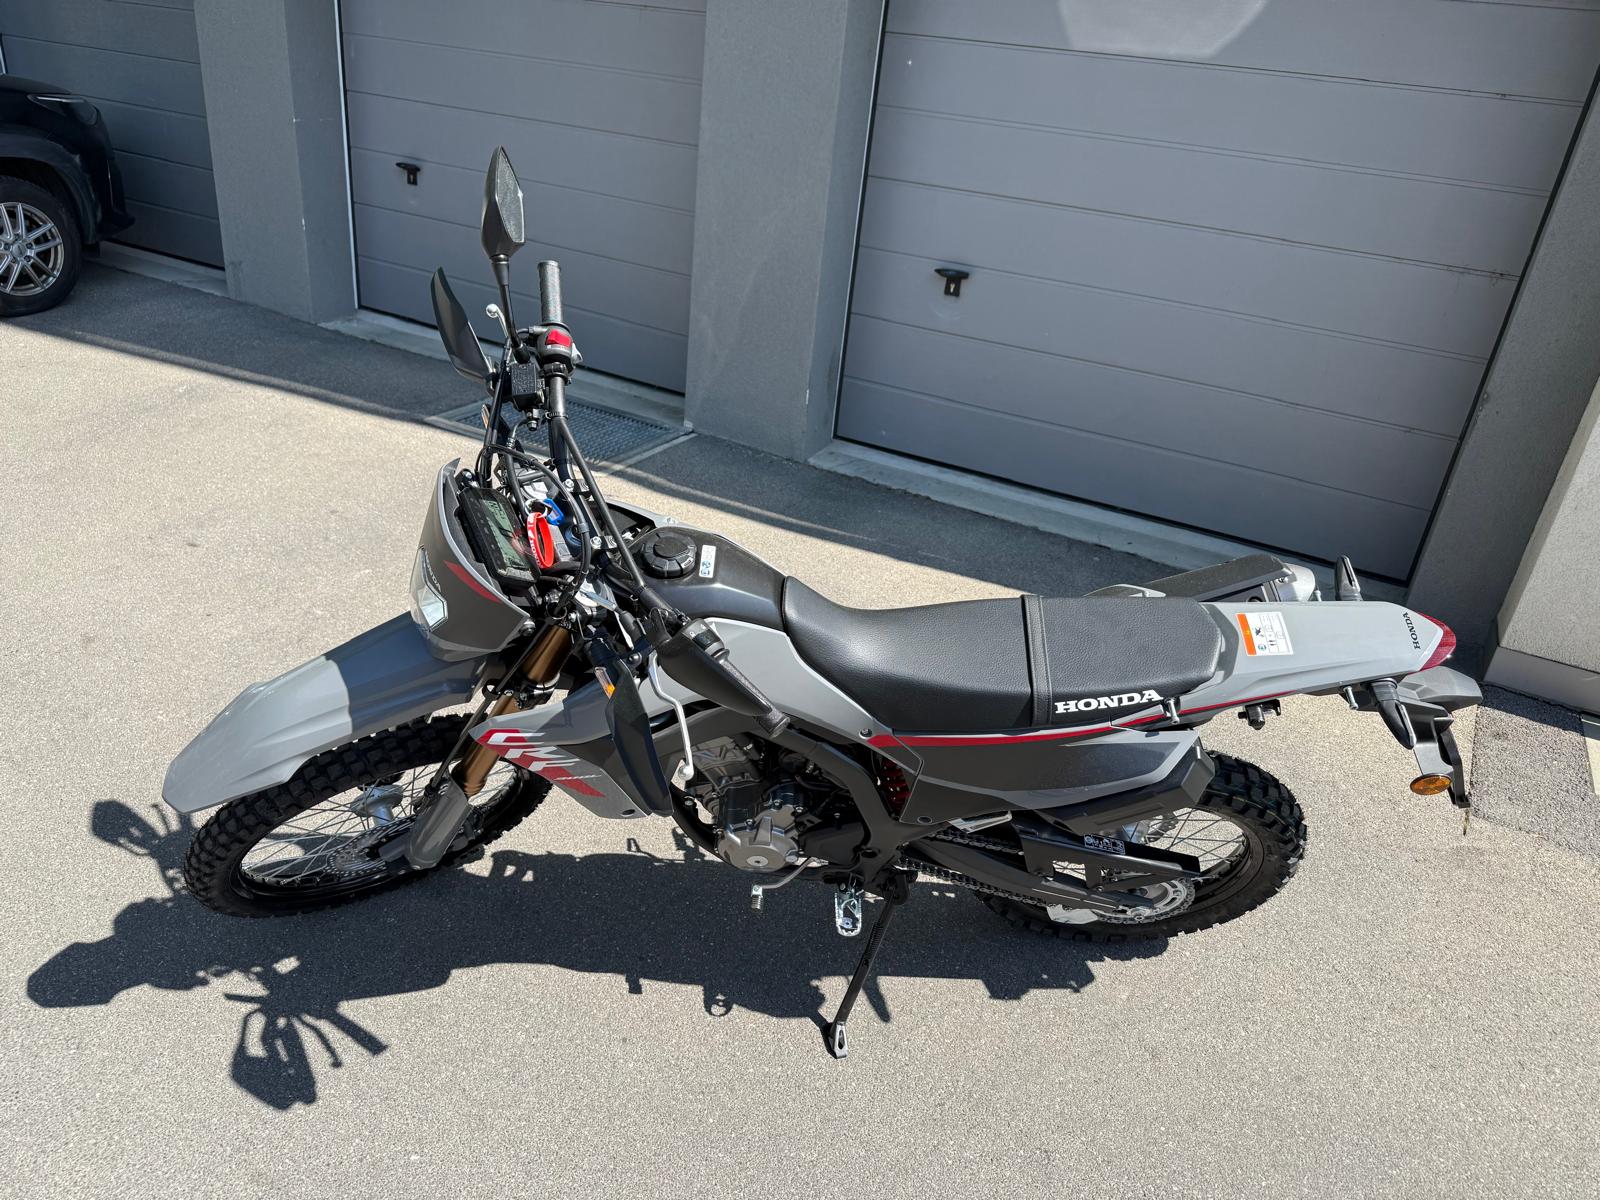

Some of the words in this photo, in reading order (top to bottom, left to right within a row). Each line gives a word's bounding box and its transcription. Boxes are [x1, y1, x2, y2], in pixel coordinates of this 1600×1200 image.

[1402, 611, 1422, 650] HONDA
[1054, 689, 1164, 714] HONDA
[486, 732, 581, 772] CRF
